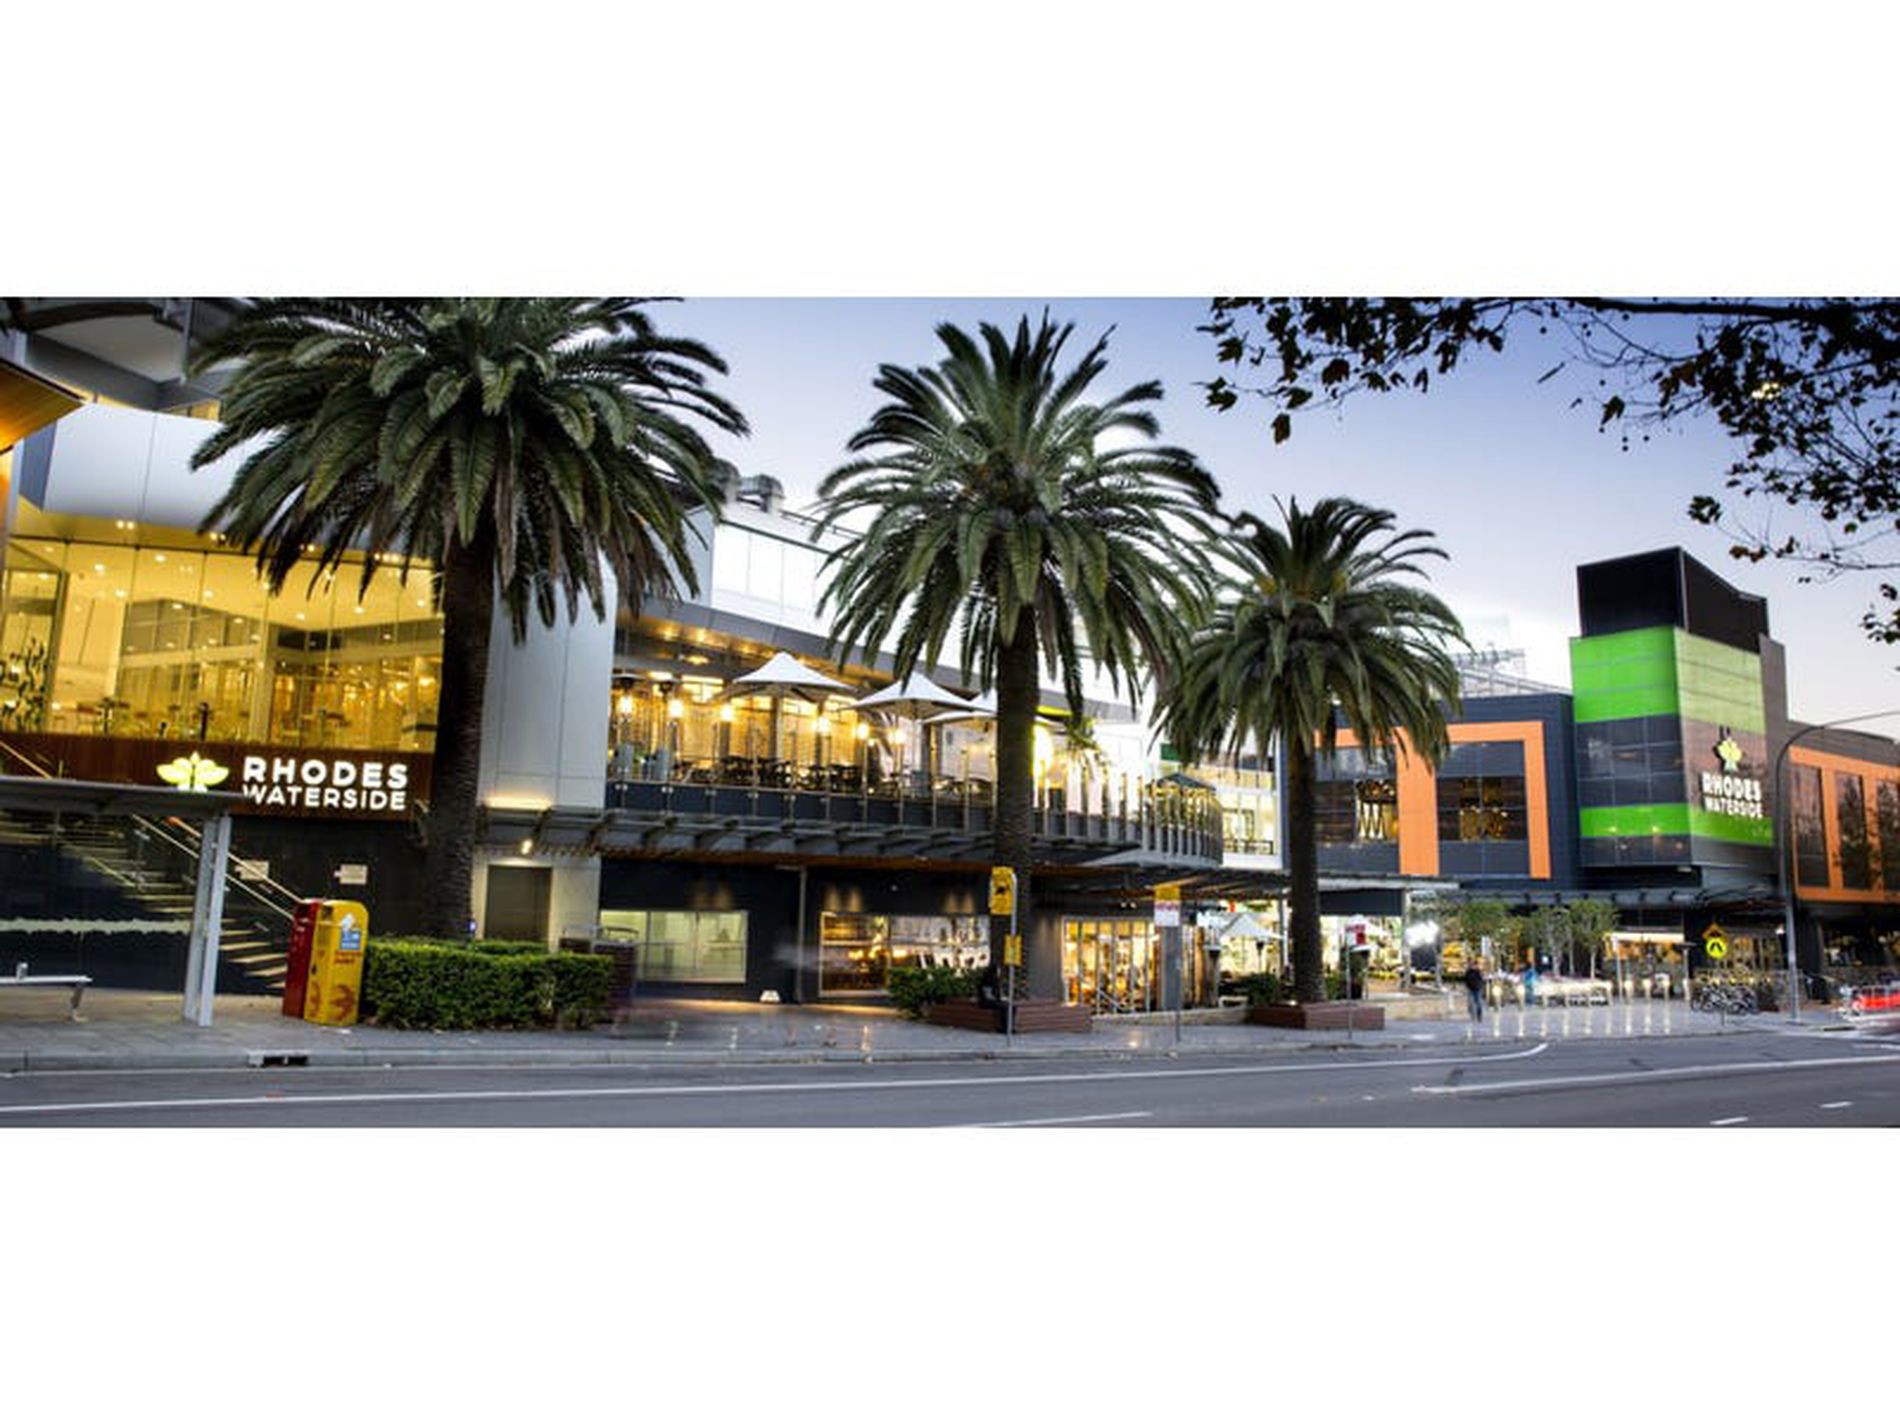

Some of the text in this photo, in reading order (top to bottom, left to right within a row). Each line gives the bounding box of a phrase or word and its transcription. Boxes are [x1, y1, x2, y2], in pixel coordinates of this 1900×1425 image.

[243, 756, 408, 789] RHODES
[1701, 771, 1761, 802] RHODES
[243, 784, 406, 811] WATERSIDE
